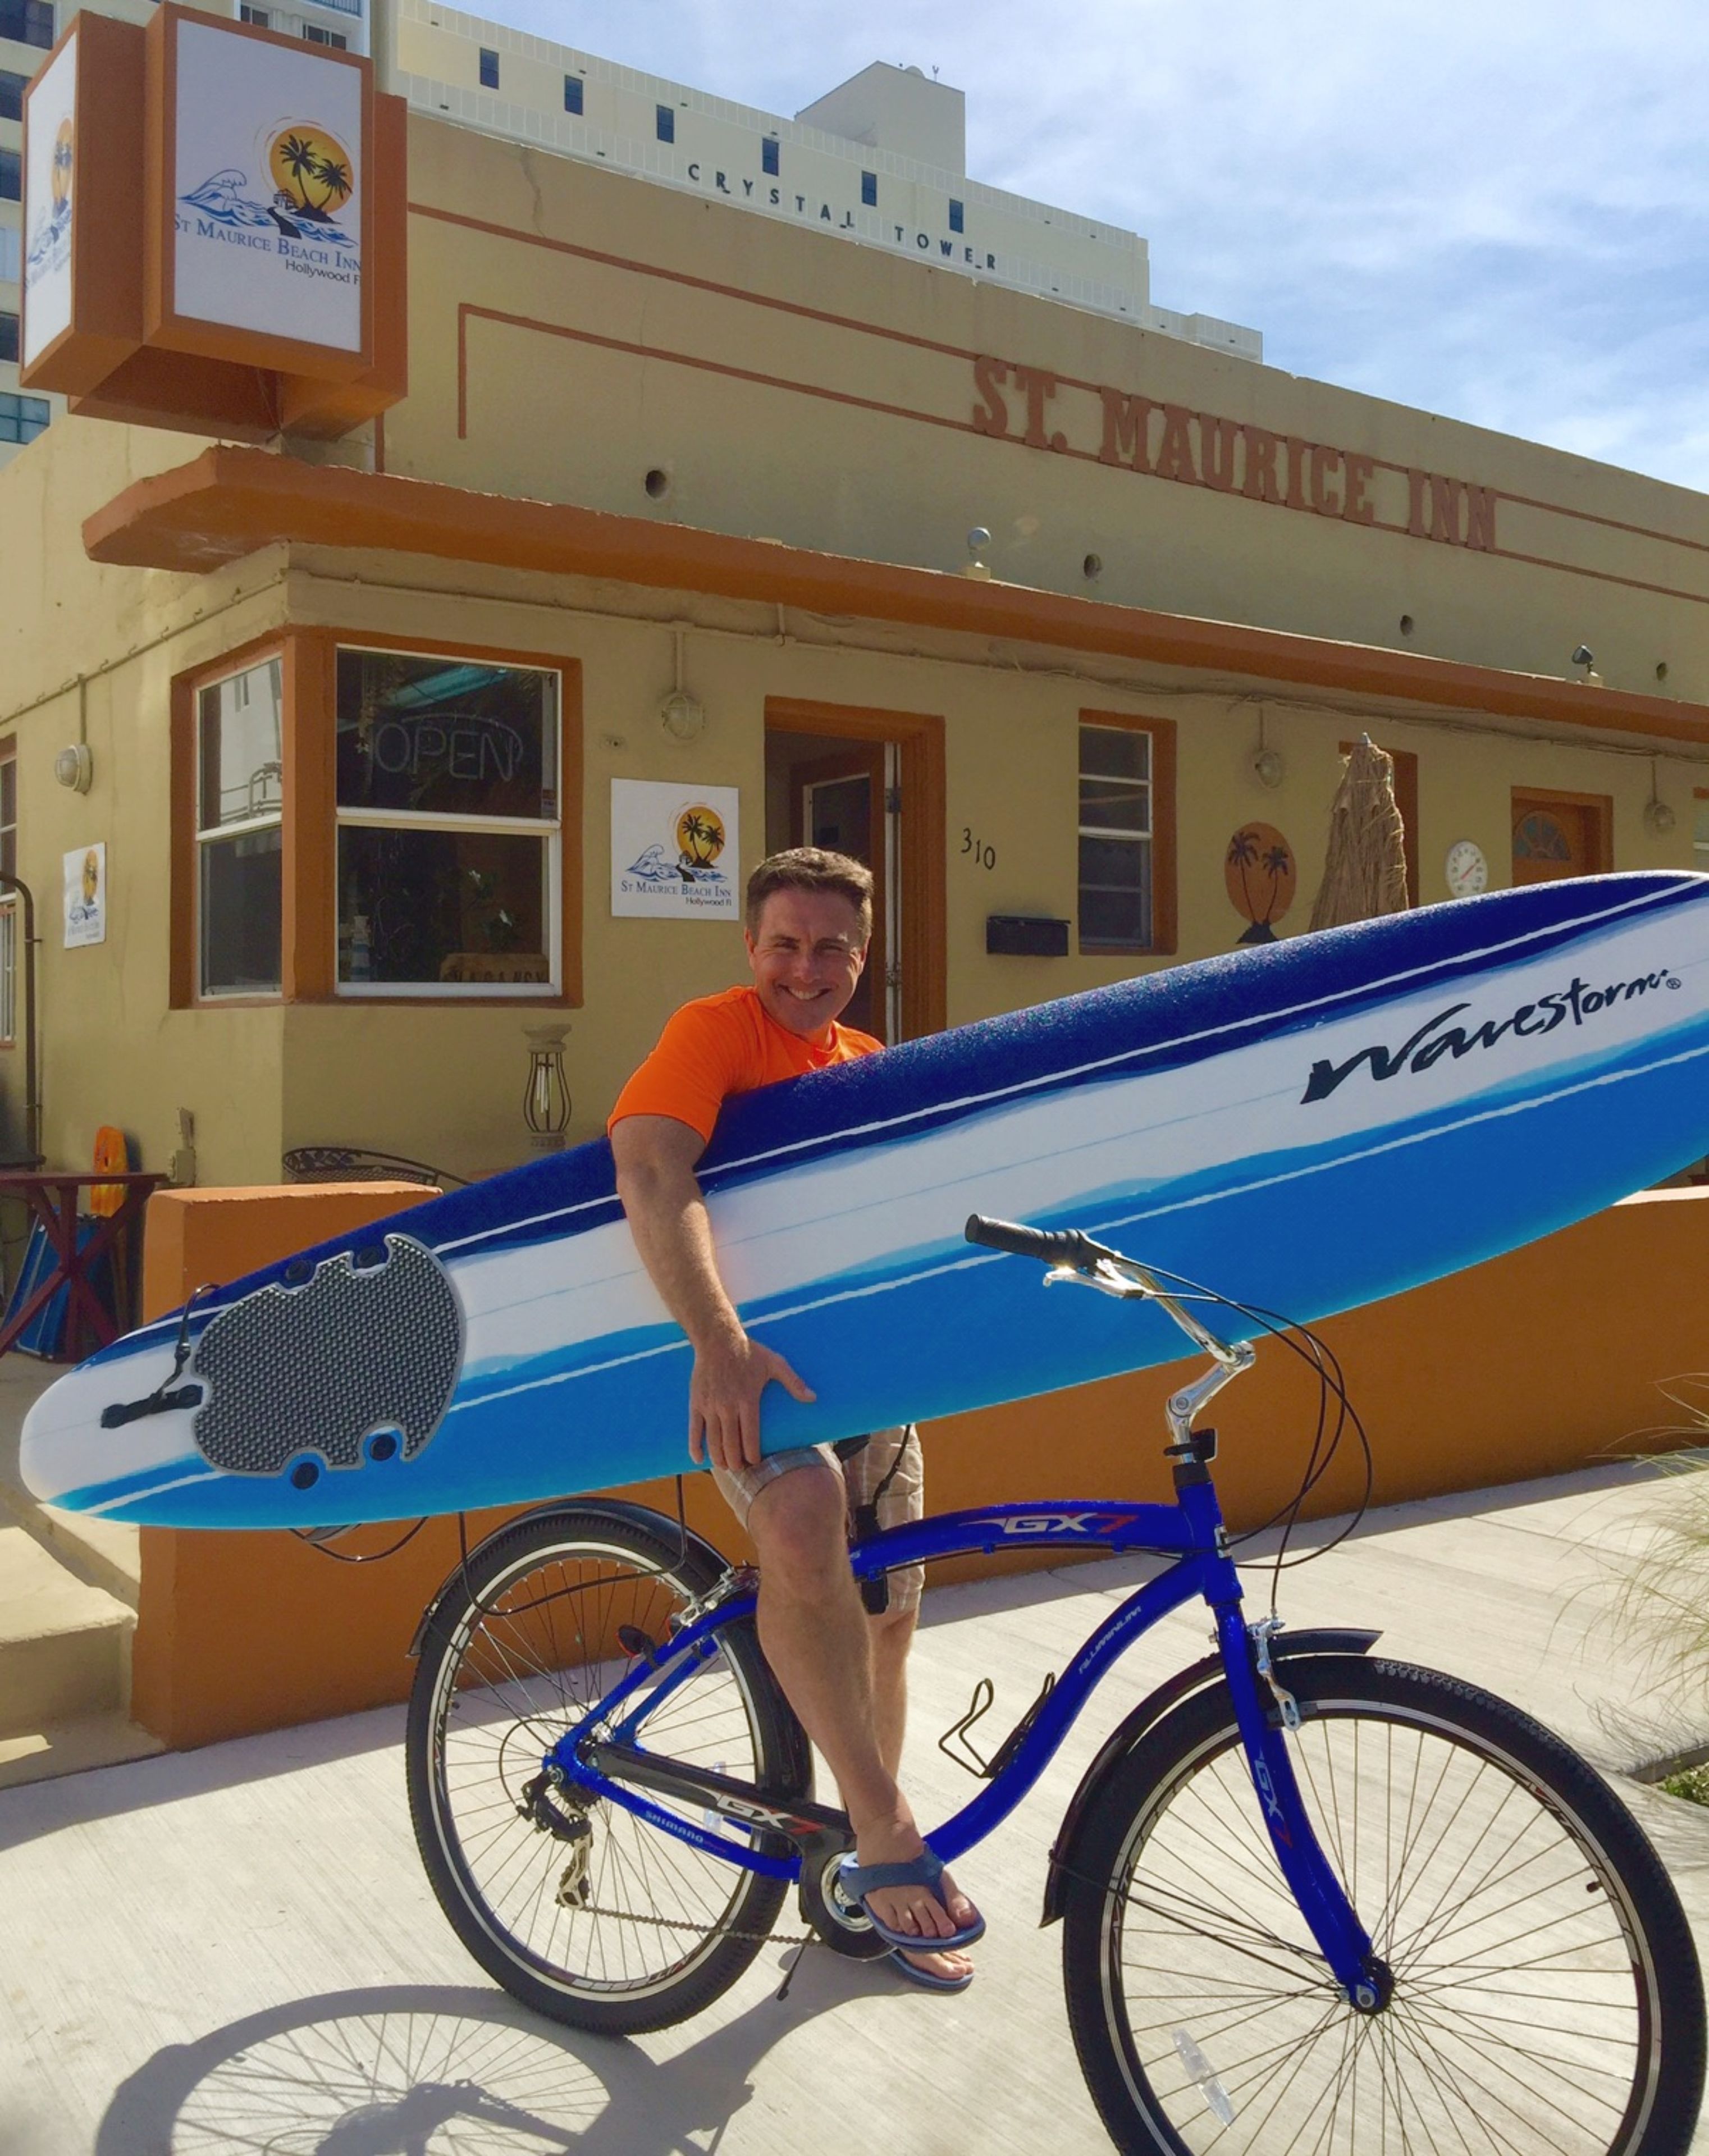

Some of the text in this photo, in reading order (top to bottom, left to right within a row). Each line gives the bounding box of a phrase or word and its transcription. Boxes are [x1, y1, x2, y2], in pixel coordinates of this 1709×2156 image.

[688, 163, 995, 270] CRYSTAL TOWER
[197, 218, 271, 252] MAURICE
[278, 237, 328, 265] BEACH
[286, 259, 361, 285] Hollywood F
[973, 355, 1497, 552] ST. MAURICE INN
[375, 721, 513, 782] OPEN
[961, 828, 995, 870] 310
[636, 881, 678, 895] MAURICE
[681, 884, 711, 896] BEACH
[715, 885, 731, 897] INN
[686, 898, 724, 907] Hollywood
[1003, 1513, 1139, 1533] GX7
[716, 1795, 827, 1835] GX7
[1254, 1758, 1292, 1848] GX7
